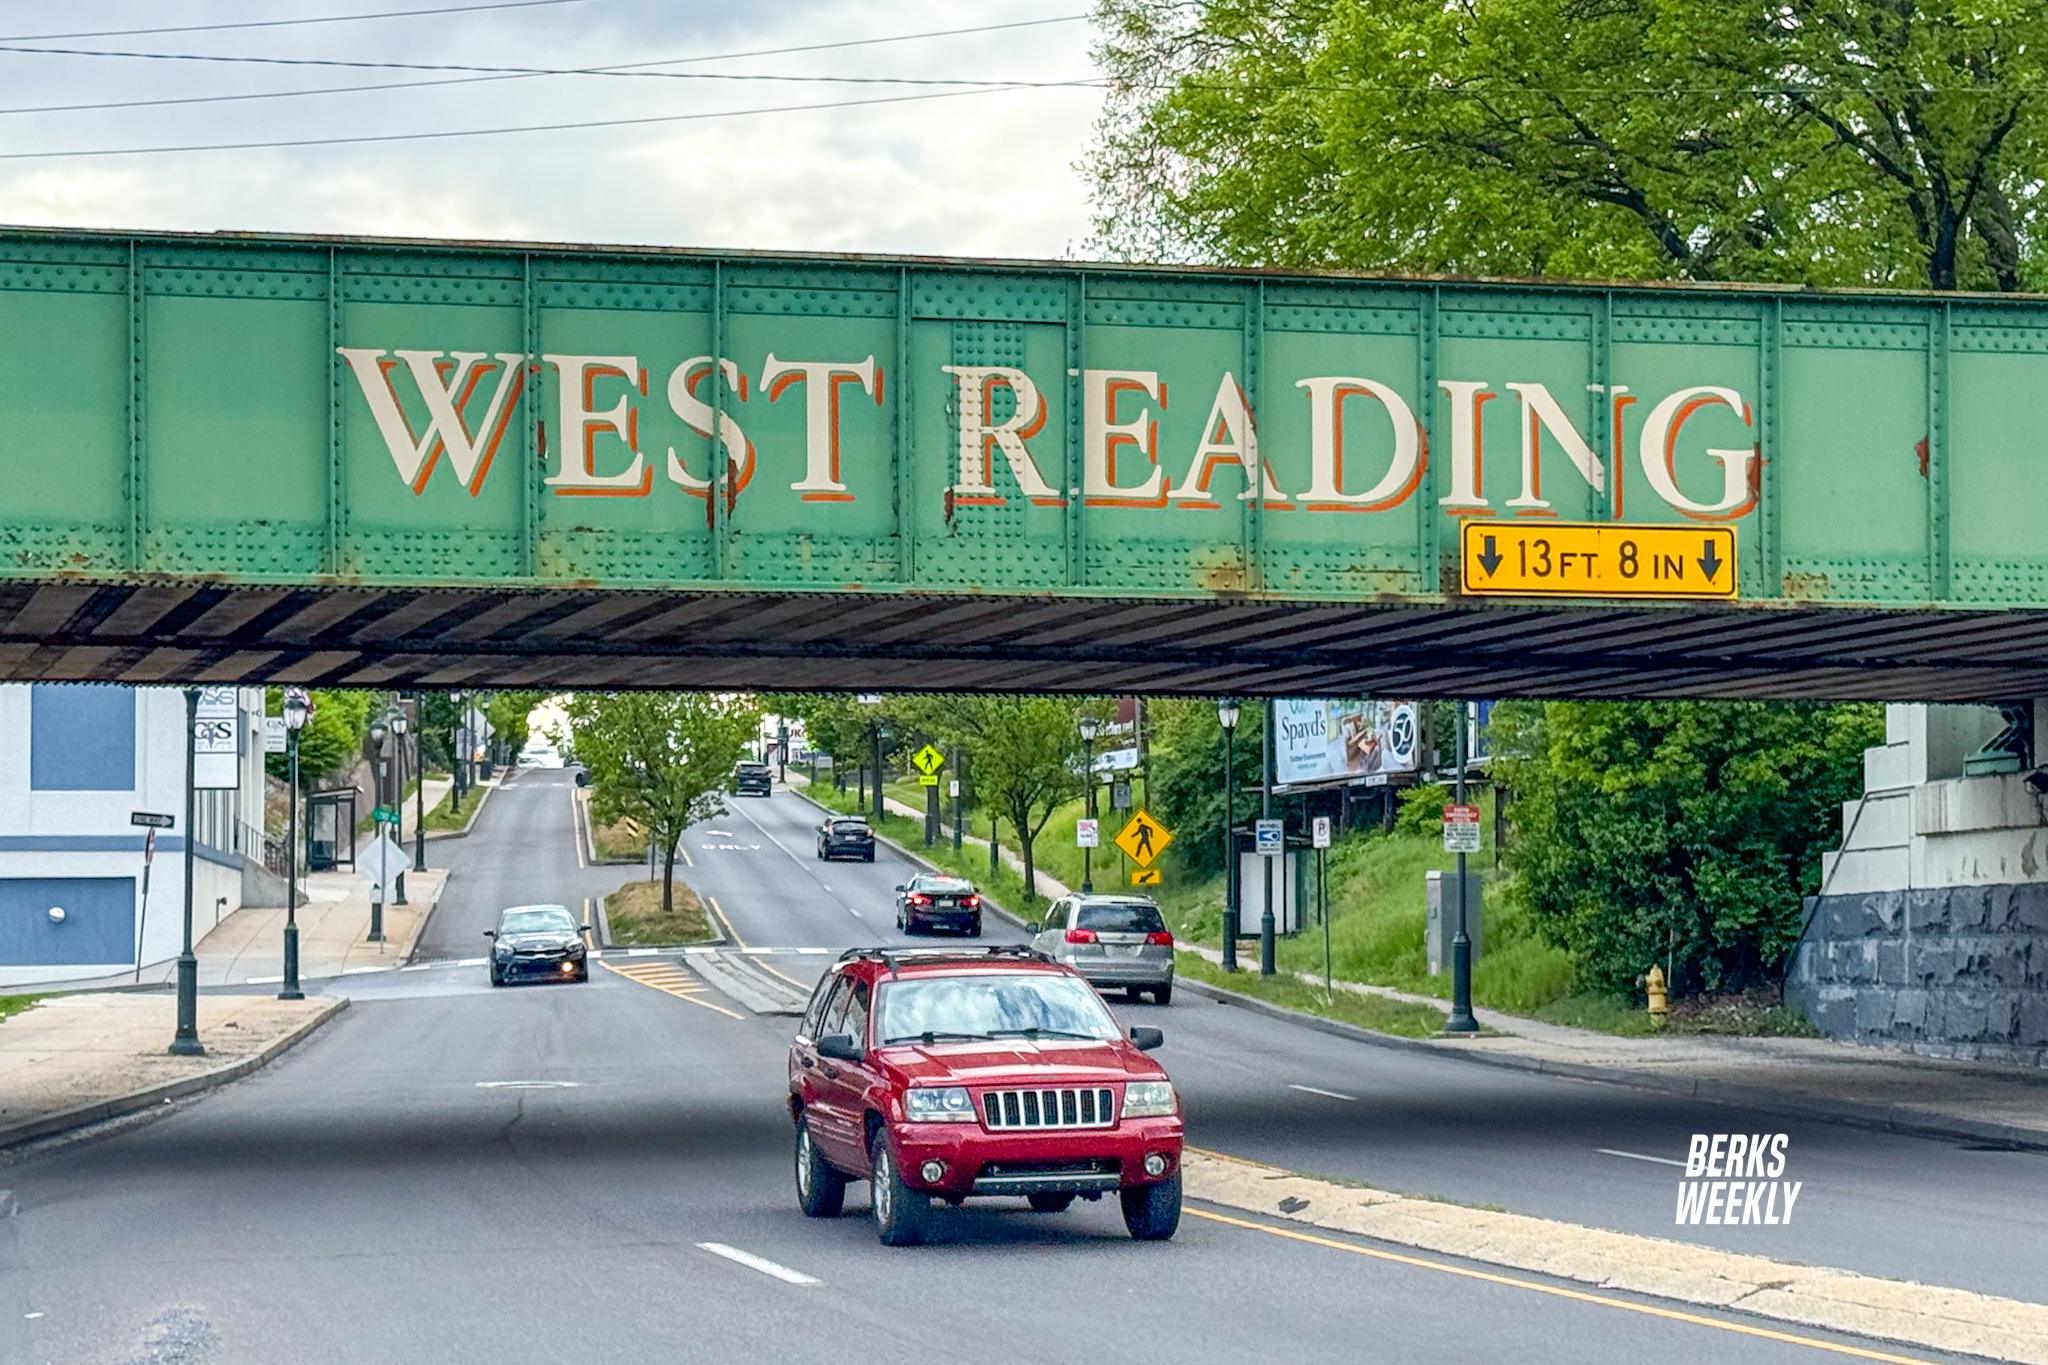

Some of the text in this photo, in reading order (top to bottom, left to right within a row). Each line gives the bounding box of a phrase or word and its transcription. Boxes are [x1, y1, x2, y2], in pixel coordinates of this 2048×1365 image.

[336, 346, 1760, 521] WEST READING
[1518, 539, 1552, 578] 13
[1619, 540, 1640, 579] 8
[1654, 554, 1684, 580] IN
[1281, 709, 1327, 751] Spayd's
[1393, 716, 1414, 751] 50
[701, 843, 761, 851] ONLY
